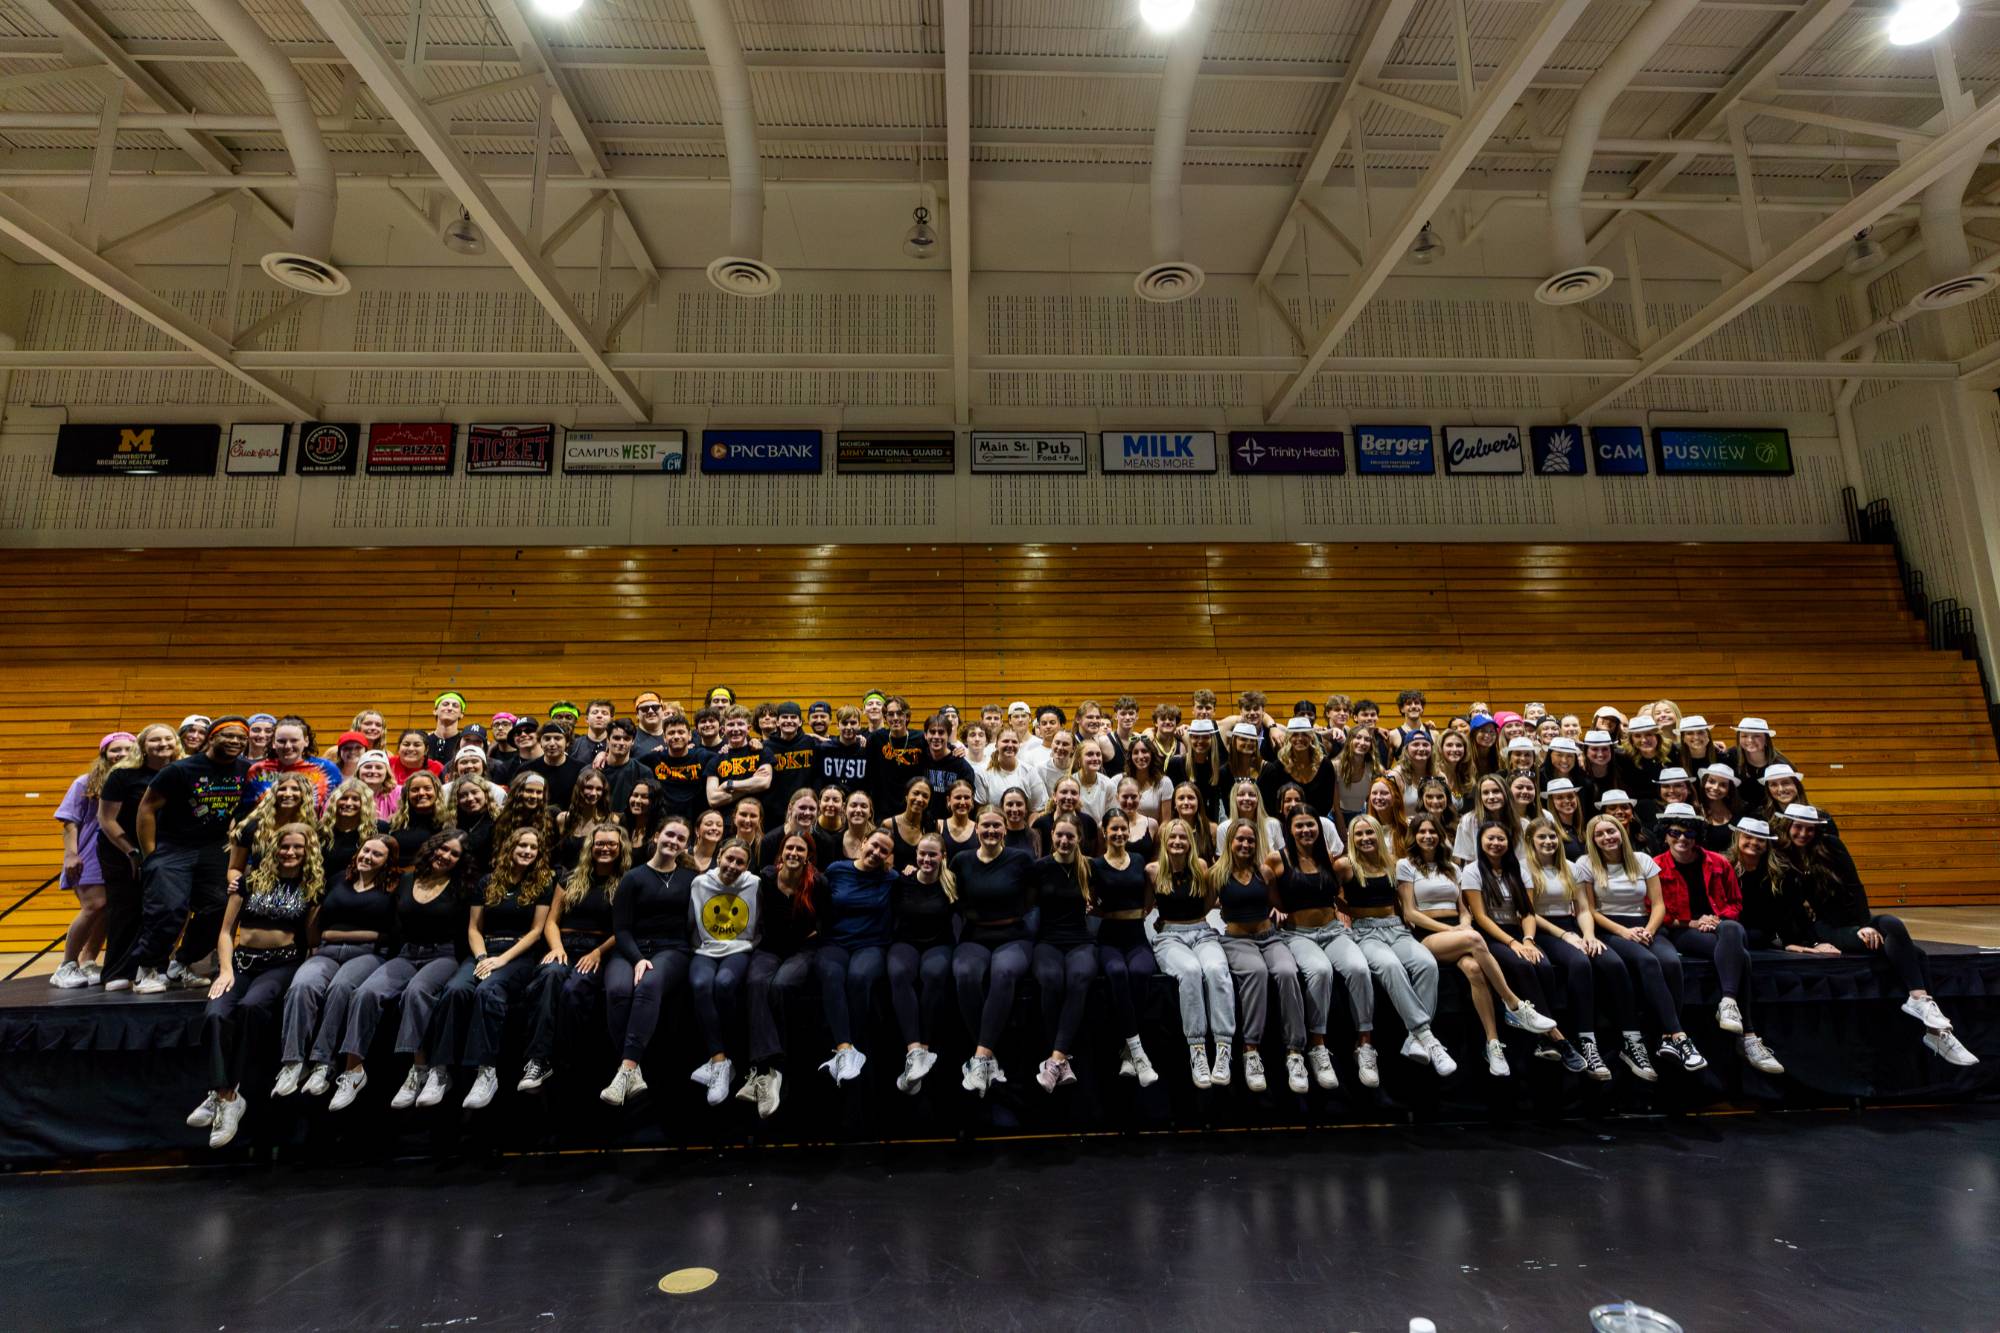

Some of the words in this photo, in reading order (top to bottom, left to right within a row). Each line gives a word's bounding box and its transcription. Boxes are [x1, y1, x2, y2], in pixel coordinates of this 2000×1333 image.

[118, 428, 155, 452] M
[501, 429, 518, 437] THE
[402, 444, 446, 455] PIZZA
[470, 435, 550, 461] TICKET
[568, 447, 619, 458] CAMPUS
[622, 444, 656, 459] WEST
[730, 444, 766, 458] PNC
[768, 444, 813, 458] BANK
[979, 441, 1009, 452] Main
[1014, 441, 1030, 452] St.
[1036, 441, 1070, 454] Pub
[1123, 435, 1194, 457] MILK
[1361, 434, 1429, 456] Berger
[1450, 433, 1520, 465] Culver's
[1600, 444, 1643, 459] CAM
[1663, 444, 1745, 460] PUSVIEW
[840, 448, 865, 457] ARMY
[867, 448, 911, 457] NATIONAL
[913, 448, 943, 457] GUARD
[1037, 454, 1057, 462] Food
[1063, 454, 1079, 462] Fun
[1268, 445, 1301, 460] Trinity
[1303, 445, 1340, 458] Health
[474, 460, 499, 468] WEST
[667, 457, 682, 471] CW
[1123, 458, 1161, 469] MEANS
[1163, 458, 1195, 469] MORE
[824, 757, 867, 779] GVSU
